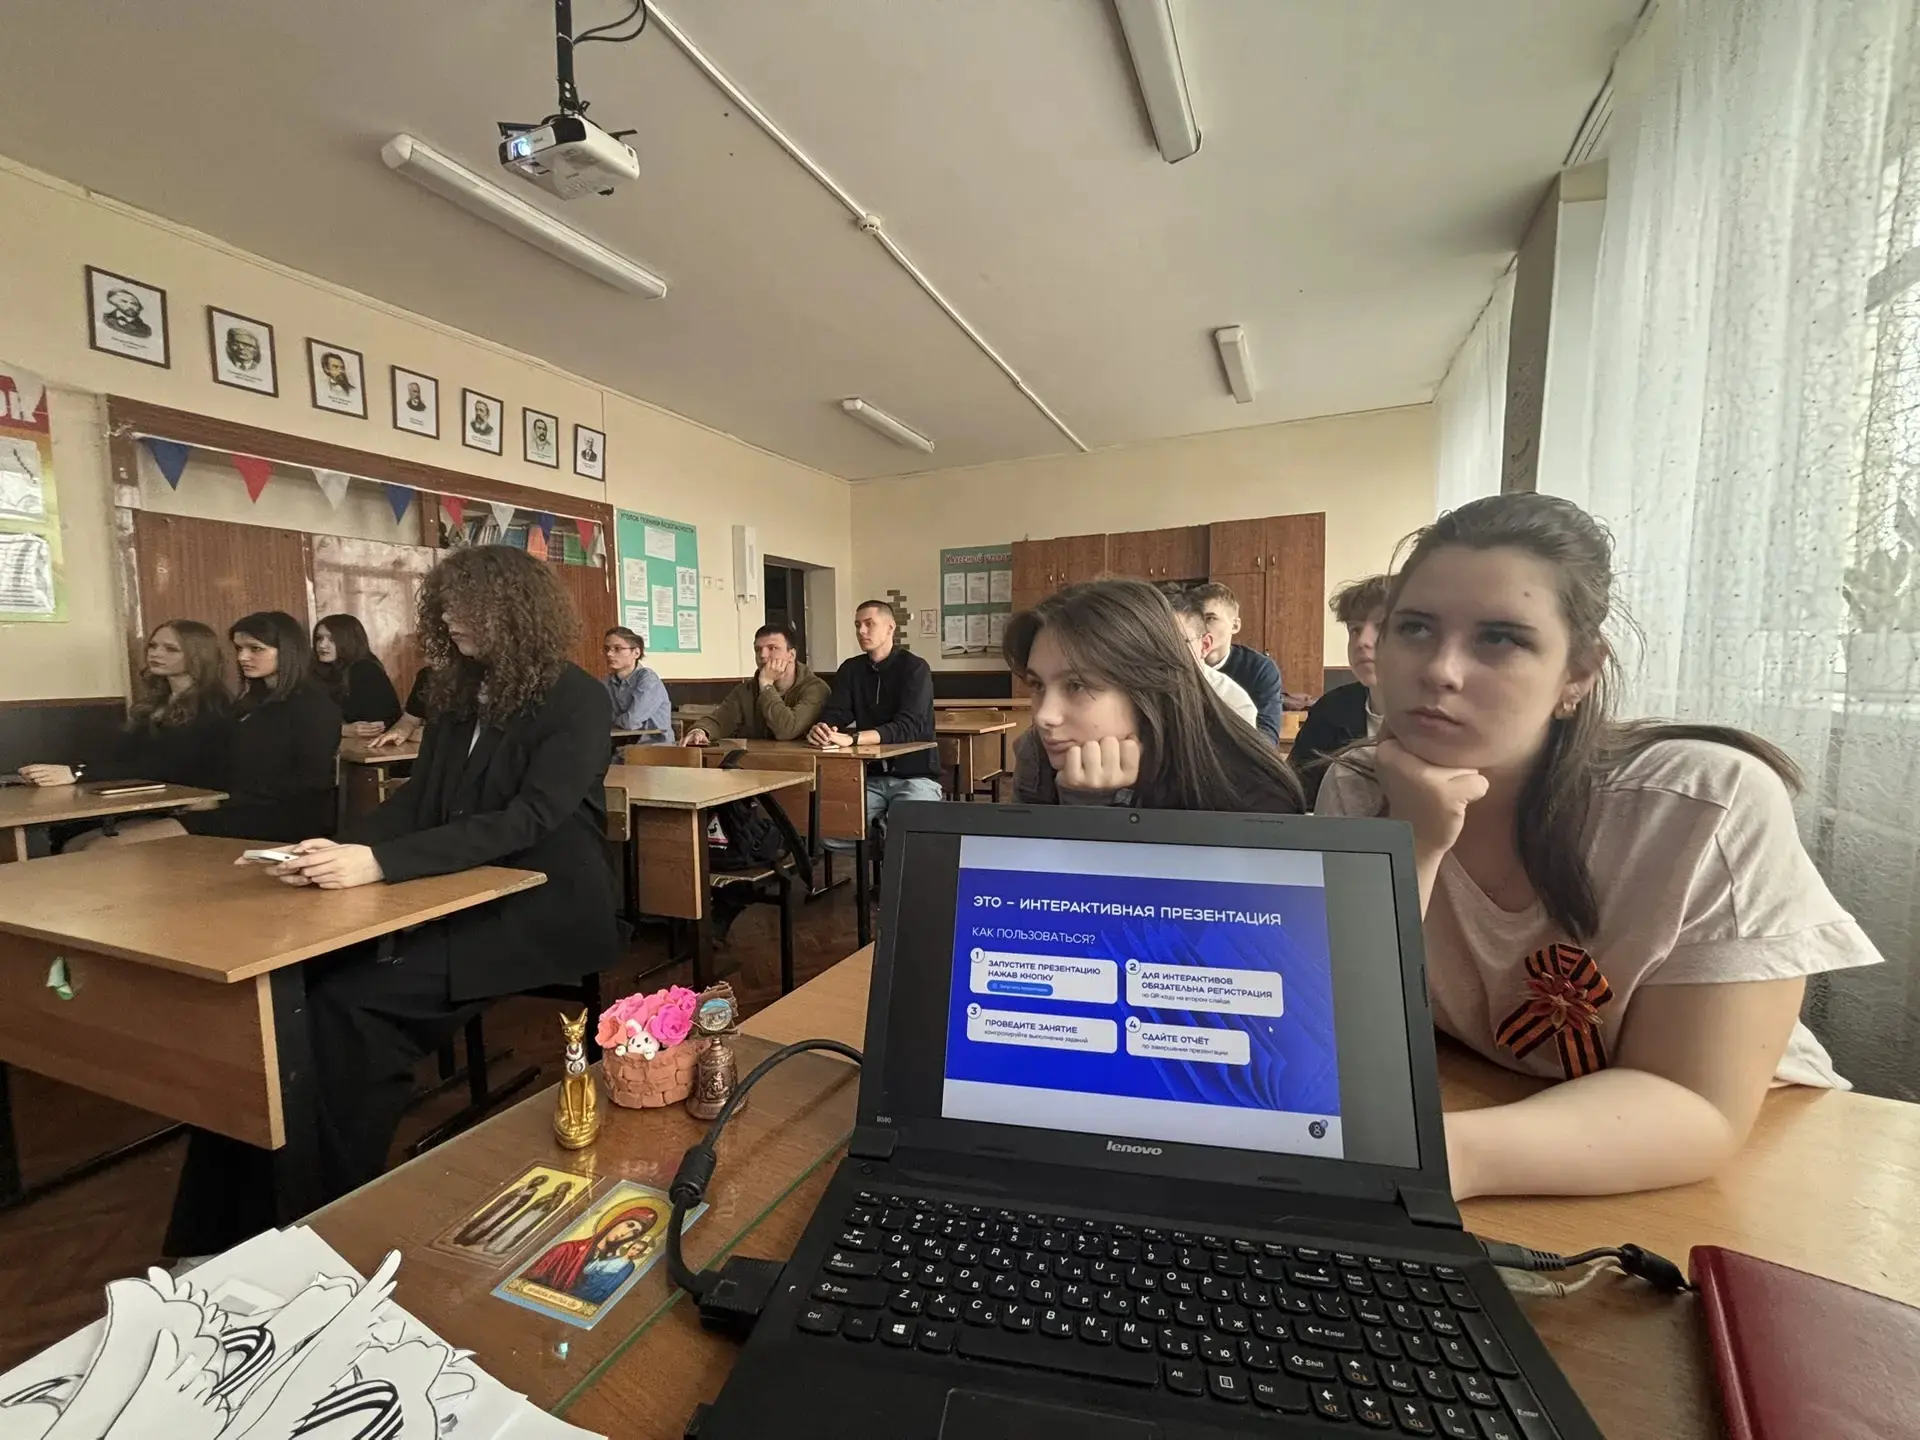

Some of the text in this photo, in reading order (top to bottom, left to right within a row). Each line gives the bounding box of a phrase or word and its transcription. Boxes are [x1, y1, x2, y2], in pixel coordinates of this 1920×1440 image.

[973, 895, 1001, 908] ЭТО
[1019, 899, 1155, 918] ИНТЕРАКТИВНАЯ
[1160, 907, 1281, 926] ПРЕЗЕНТАЦИЯ
[972, 927, 1096, 945] КАК ПОЛЬЗОВАТЬСЯ?
[975, 951, 980, 960] 1
[988, 960, 1101, 975] ЗАПУСТИТЕ ПРЕЗЕНТАЦИЮ
[1129, 963, 1137, 971] 2
[988, 970, 1054, 981] НАЖАВ КНОПКУ
[1141, 972, 1233, 985] ДЛЯ ИНТЕРАКТИВОВ
[1142, 982, 1273, 999] ОБЯЗАТЕЛЬНА РЕГИСТРАЦИЯ
[970, 1007, 978, 1015] 3
[985, 1019, 1079, 1034] ПРОВЕДИТЕ ЗАНЯТИЕ
[1129, 1020, 1137, 1029] 4
[1142, 1033, 1209, 1045] СДАЙТЕ ОТЧЁТ
[1106, 1140, 1163, 1156] lenovo
[891, 1234, 901, 1243] Q
[924, 1239, 936, 1247] W
[957, 1243, 967, 1251] E
[991, 1248, 1000, 1256] R
[1026, 1252, 1034, 1260] T
[892, 1260, 901, 1268] A
[1060, 1257, 1068, 1265] Y
[925, 1265, 934, 1273] S
[1095, 1262, 1104, 1270] U
[960, 1270, 970, 1278] D
[995, 1275, 1004, 1283] F
[1030, 1279, 1040, 1288] G
[1067, 1285, 1077, 1293] H
[899, 1289, 910, 1298] Z
[1104, 1291, 1111, 1299] J
[935, 1294, 945, 1303] X
[1140, 1296, 1150, 1304] K
[1009, 1305, 1018, 1314] V
[1179, 1301, 1187, 1310] L
[1046, 1311, 1056, 1319] B
[1085, 1317, 1095, 1326] N
[1124, 1323, 1136, 1332] M
[1325, 1329, 1345, 1337] Enter
[1413, 1336, 1420, 1344] 5
[1451, 1342, 1458, 1350] 6
[1306, 1359, 1324, 1368] Shift
[1172, 1370, 1183, 1378] Alt
[1429, 1371, 1436, 1379] 2
[1469, 1377, 1477, 1385] 3
[1258, 1384, 1273, 1394] Ctrl
